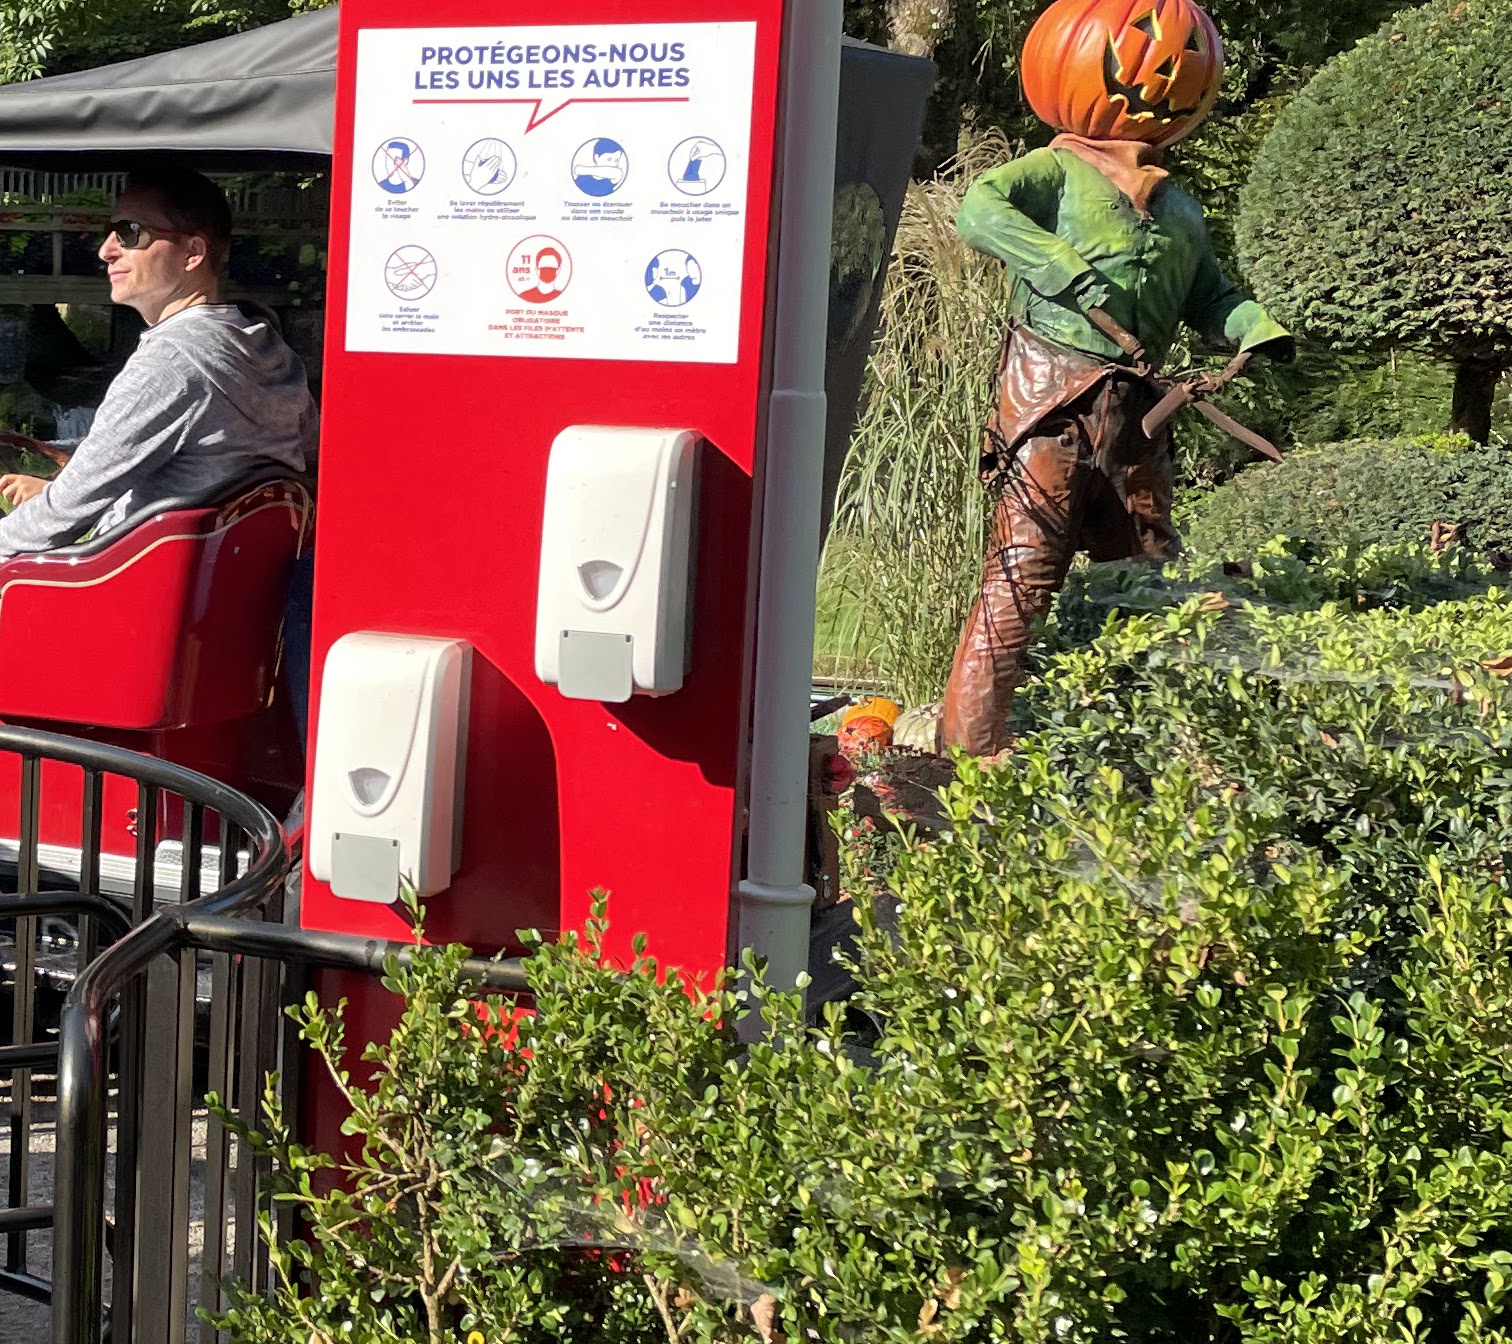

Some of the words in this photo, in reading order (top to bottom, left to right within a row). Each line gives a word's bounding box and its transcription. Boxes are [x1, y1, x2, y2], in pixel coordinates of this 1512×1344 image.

[421, 41, 686, 66] PROTÉGEONS-NOUS
[414, 70, 460, 89] LES
[468, 69, 520, 89] UNS
[528, 69, 575, 88] LES
[583, 67, 690, 88] AUTRES
[521, 255, 531, 264] 11
[512, 266, 531, 274] ans
[664, 267, 677, 276] 1m
